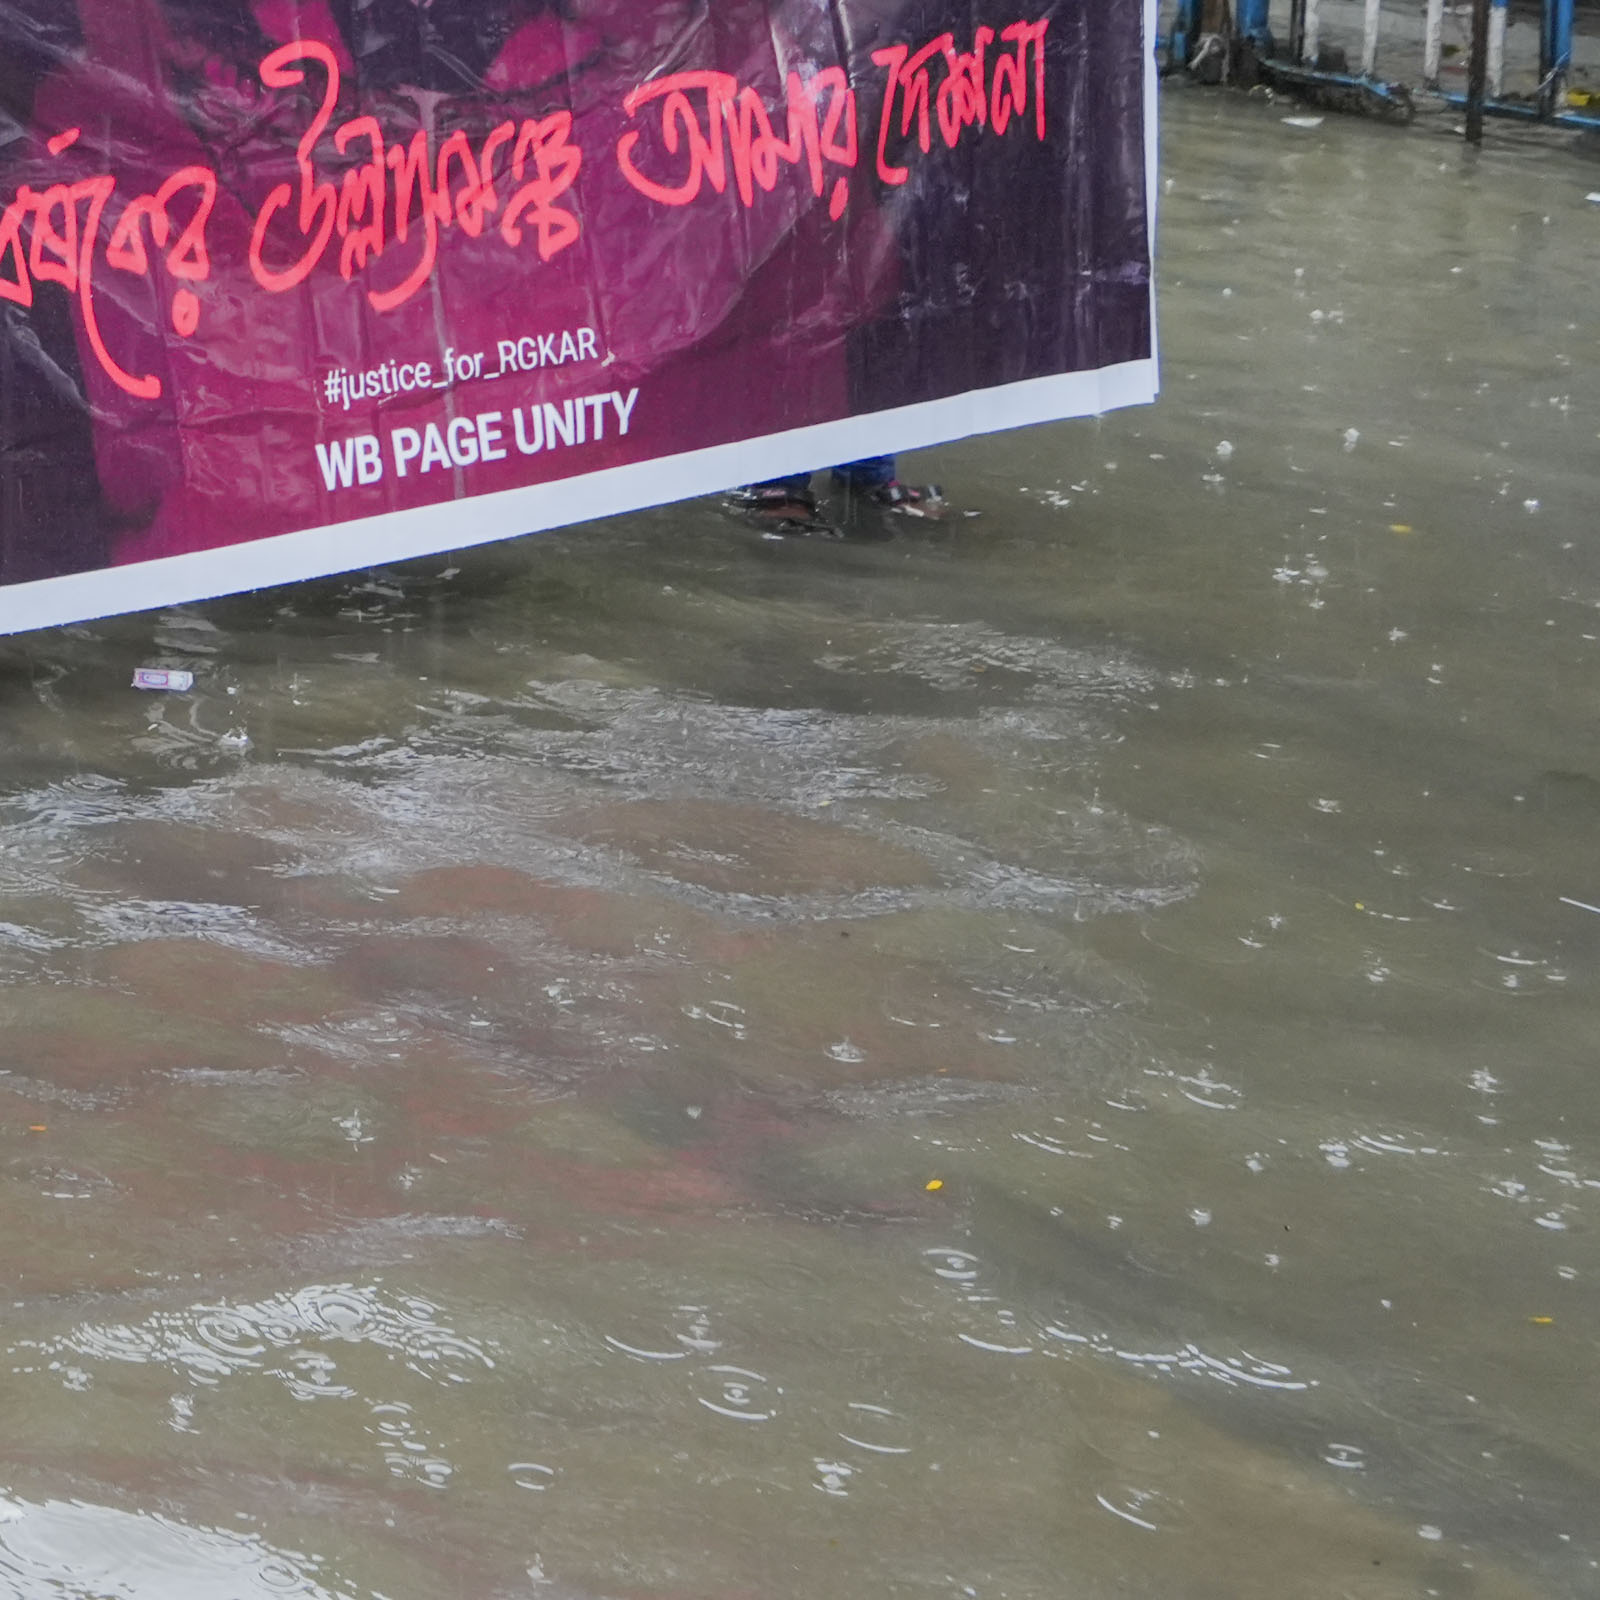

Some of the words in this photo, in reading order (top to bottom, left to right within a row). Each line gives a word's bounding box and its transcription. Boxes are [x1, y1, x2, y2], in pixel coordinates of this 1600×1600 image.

[323, 327, 598, 411] #justice_for_RGKAR
[315, 435, 384, 492] WB
[391, 411, 507, 478] PAGE
[514, 388, 639, 455] UNITY
